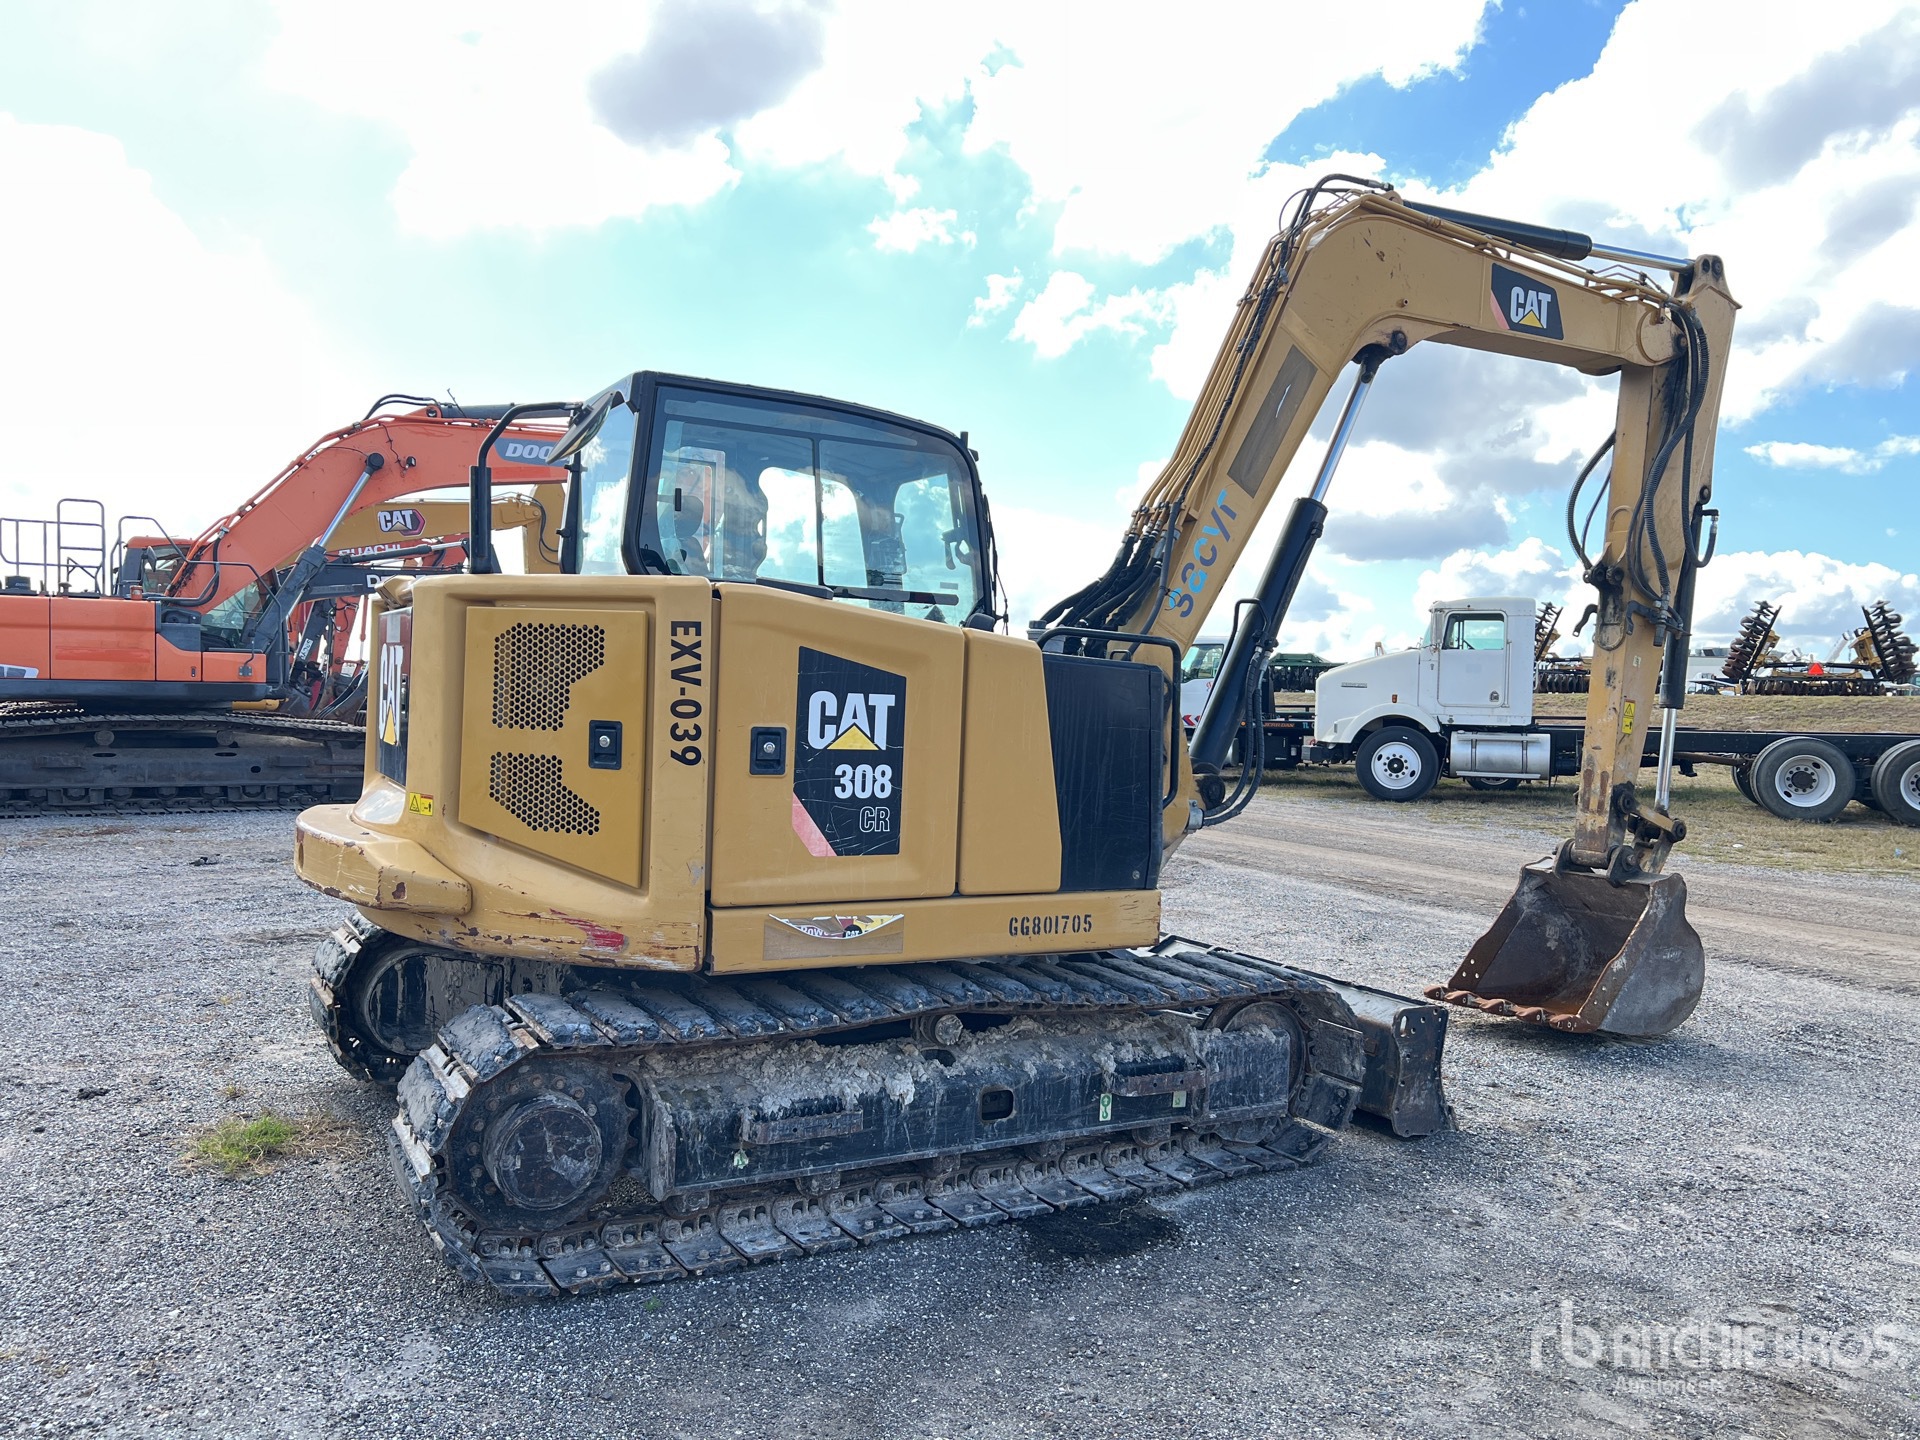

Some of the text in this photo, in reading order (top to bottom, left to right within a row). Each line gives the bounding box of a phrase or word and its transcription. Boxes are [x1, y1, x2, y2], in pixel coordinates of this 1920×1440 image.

[1510, 286, 1552, 329] CAT
[377, 509, 413, 532] CAT
[379, 643, 404, 746] CAT
[670, 620, 702, 766] EXV-039
[807, 690, 896, 751] CAT
[834, 763, 893, 799] 308
[859, 806, 891, 833] CR
[1008, 914, 1093, 937] GG801705
